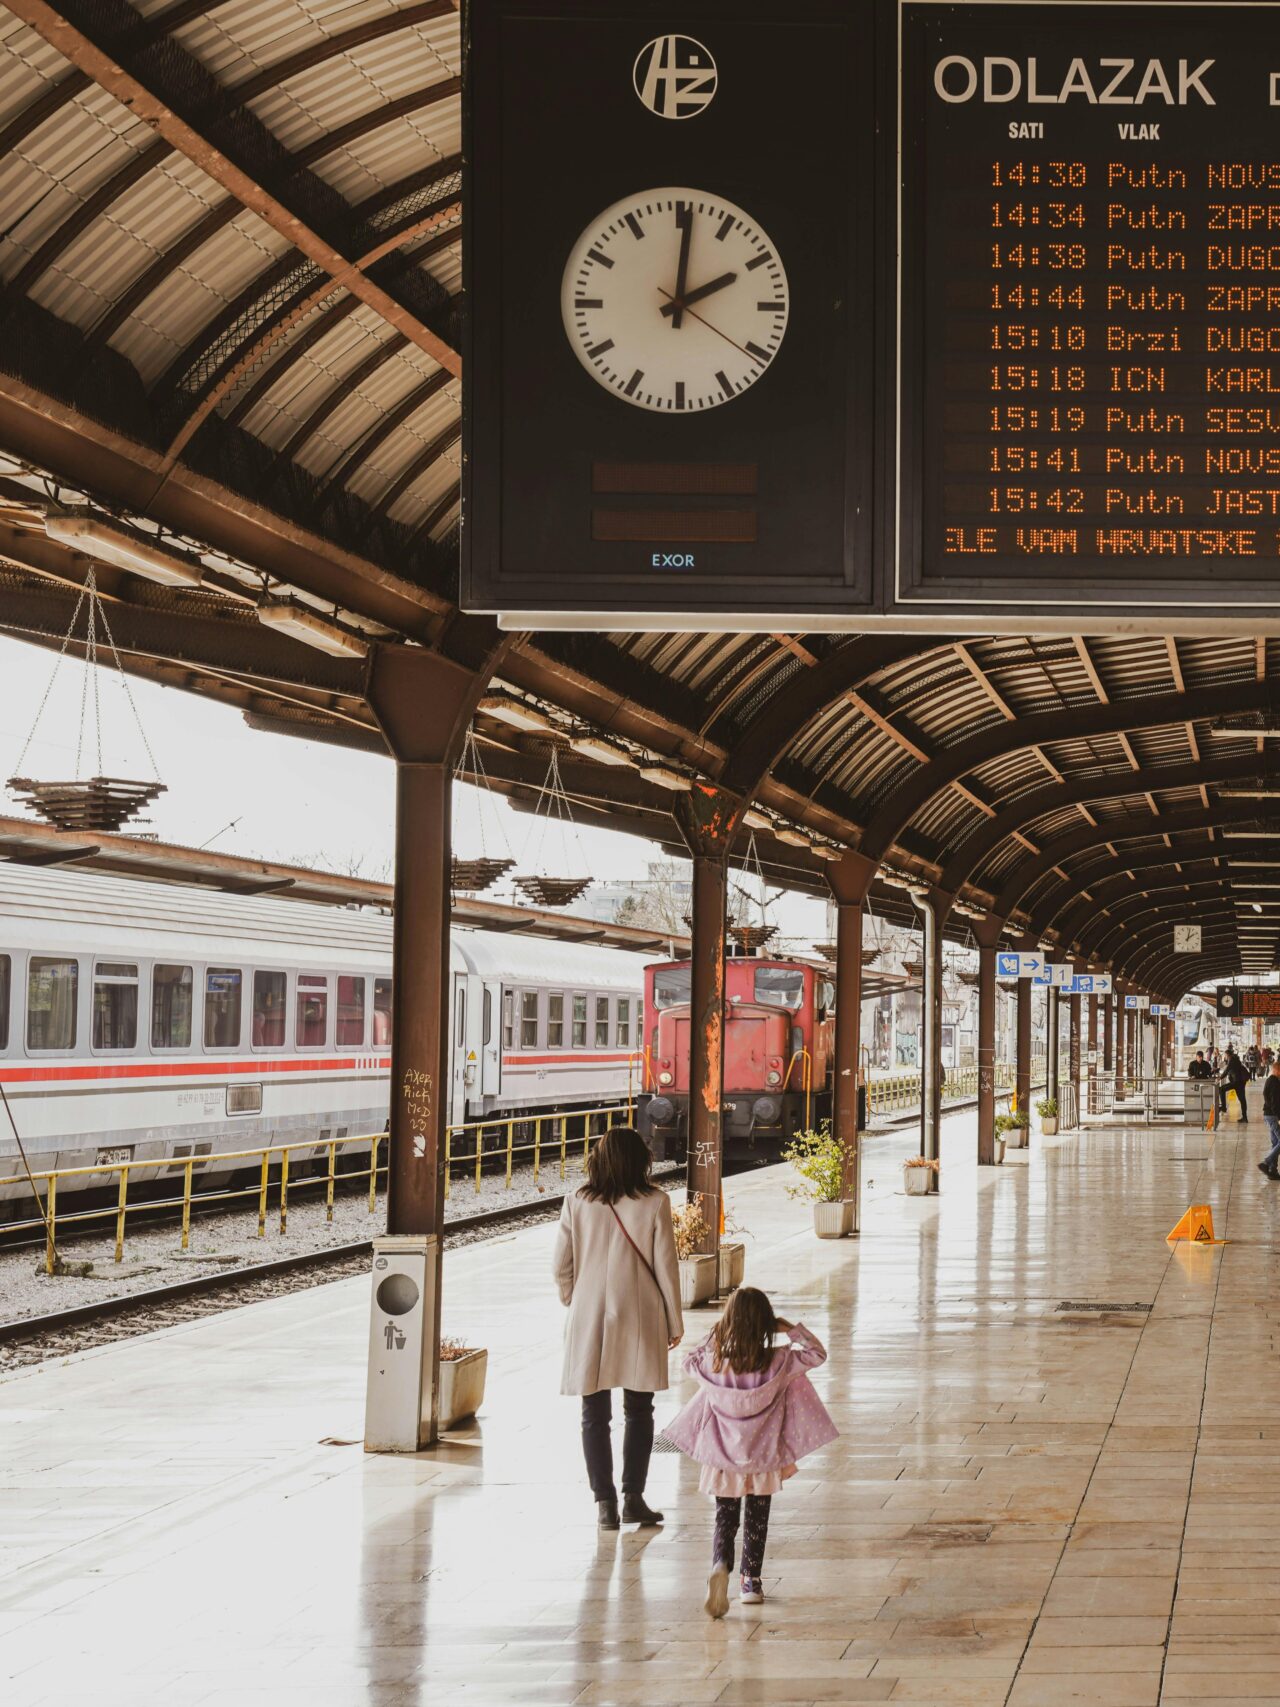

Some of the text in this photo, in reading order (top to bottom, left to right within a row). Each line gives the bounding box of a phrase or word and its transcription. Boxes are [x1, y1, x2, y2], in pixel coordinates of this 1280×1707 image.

[934, 56, 1217, 105] ODLAZAK
[1008, 121, 1044, 140] SATI
[1117, 123, 1161, 141] VLAK
[992, 161, 1087, 188] 14:30
[1108, 162, 1186, 188] Putn
[991, 202, 1086, 228] 14:34
[1108, 203, 1186, 229] Putn
[991, 243, 1086, 269] 14:38
[1107, 244, 1186, 270] Putn
[991, 284, 1086, 310] 14:44
[1107, 285, 1185, 311] Putn
[991, 325, 1086, 351] 15:10
[1107, 325, 1182, 352] Brzi
[991, 365, 1085, 392] 15:18
[1110, 366, 1165, 392] ICN
[990, 406, 1085, 432] 15:19
[1106, 407, 1185, 433] Putn
[990, 447, 1081, 473] 15:41
[1105, 447, 1185, 473] Putn
[990, 487, 1085, 513] 15:42
[1105, 488, 1184, 514] Putn
[1016, 528, 1078, 554] VAM
[1095, 529, 1257, 555] HRVATSKE
[652, 553, 695, 567] EXOR
[1058, 969, 1066, 982] 1
